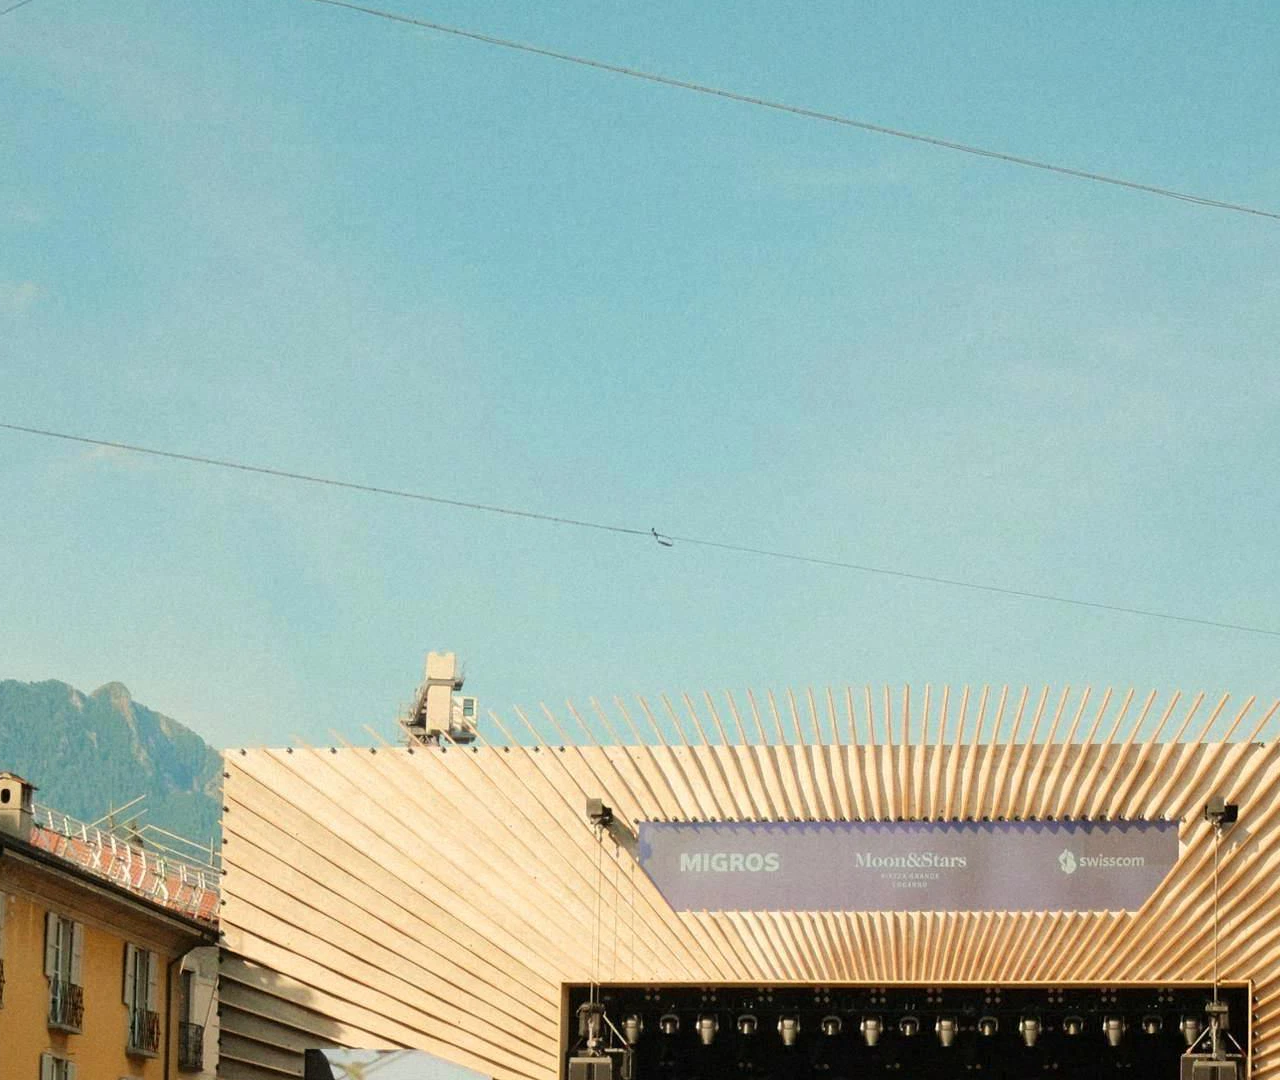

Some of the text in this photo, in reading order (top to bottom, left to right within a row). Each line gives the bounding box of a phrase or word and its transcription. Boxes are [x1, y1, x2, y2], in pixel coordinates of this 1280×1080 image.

[680, 852, 780, 872] MIGROS
[855, 851, 967, 868] Moon&Stars
[1079, 853, 1145, 867] swisscom
